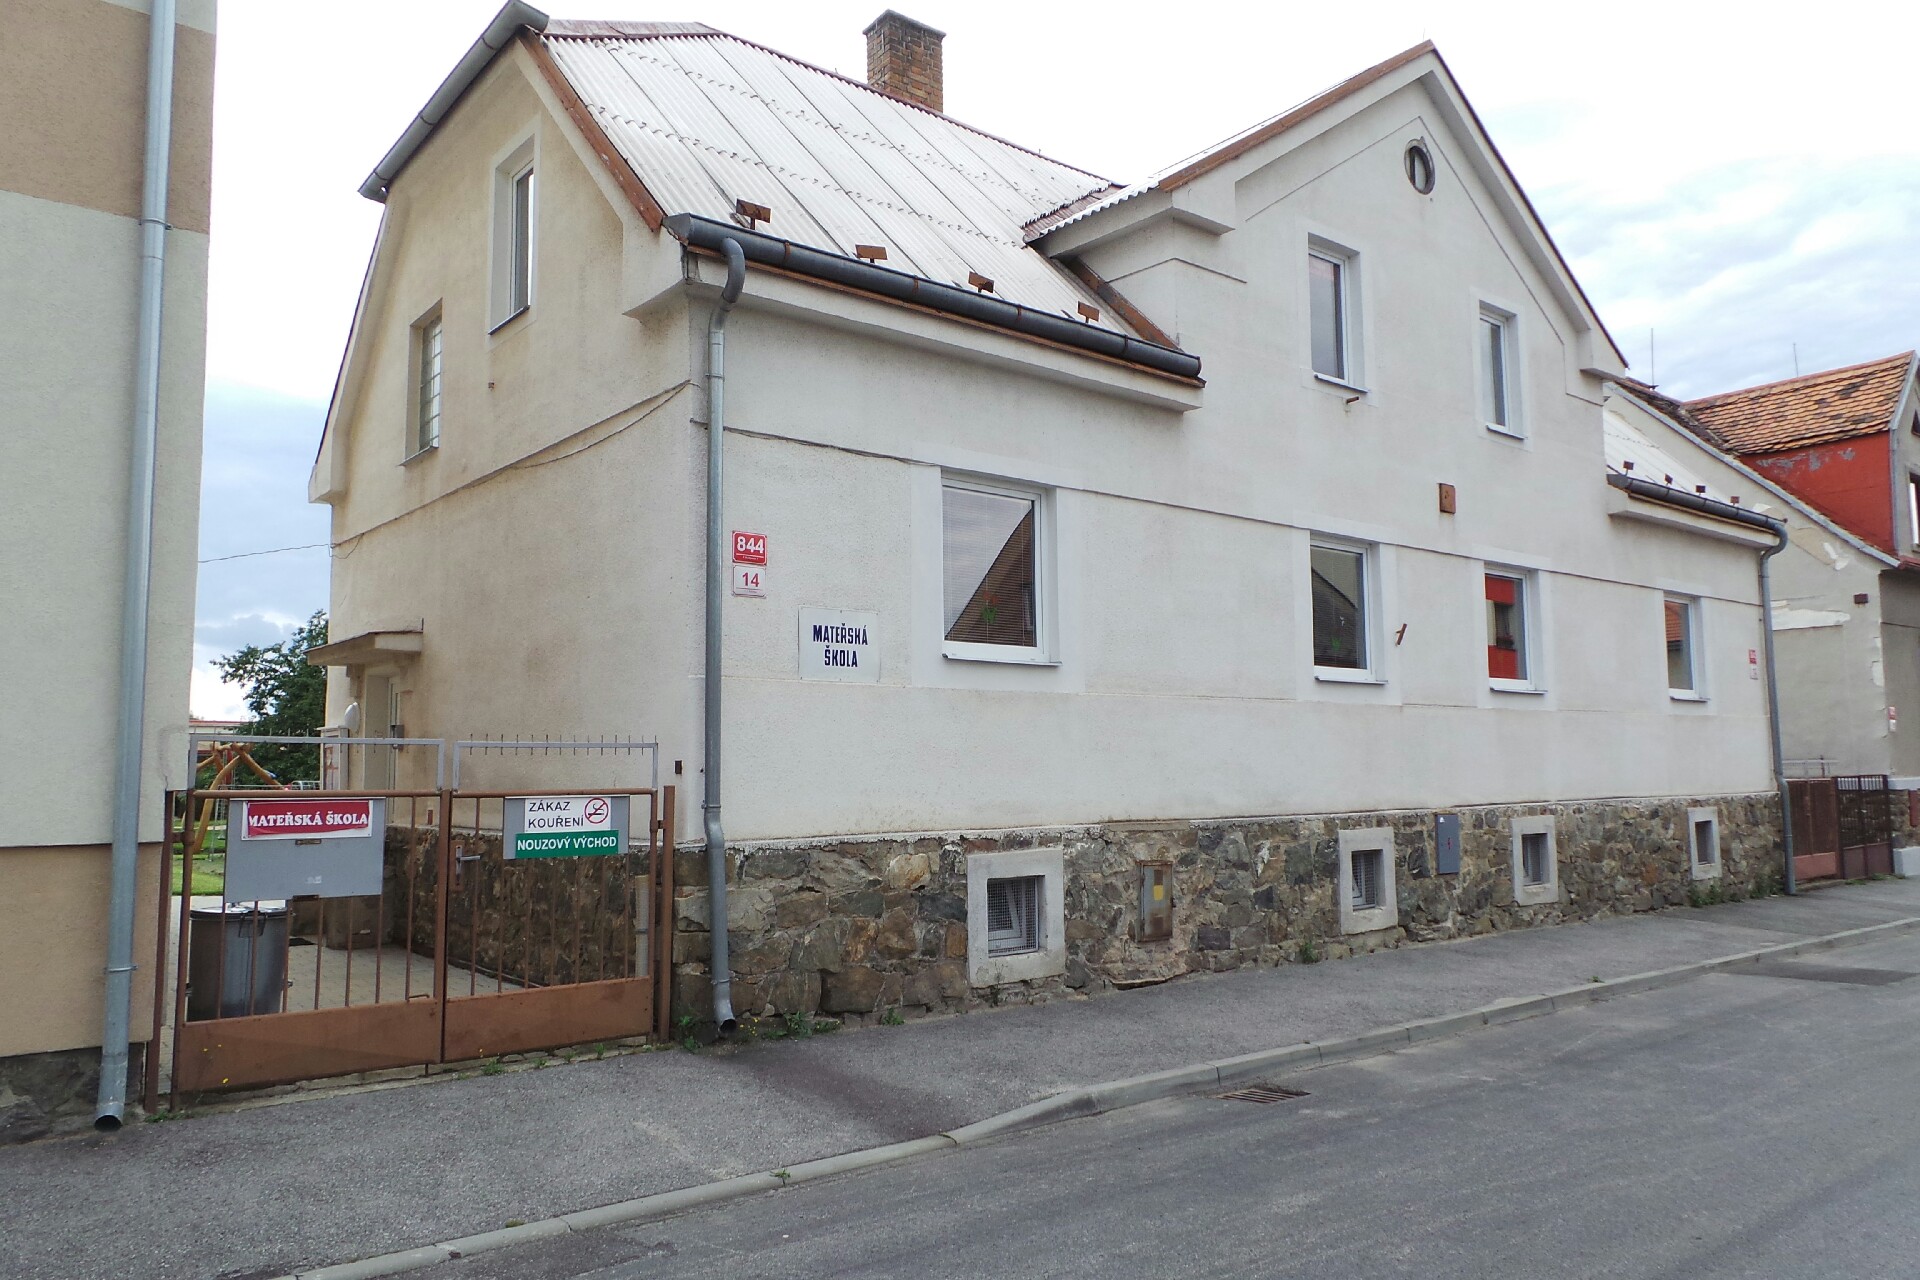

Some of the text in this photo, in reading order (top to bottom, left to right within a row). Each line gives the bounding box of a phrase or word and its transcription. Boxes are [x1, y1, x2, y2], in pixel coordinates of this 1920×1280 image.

[737, 536, 765, 554] 844
[742, 572, 760, 587] 14
[812, 623, 869, 645] MATEŘSKÁ
[824, 645, 858, 668] ŠKOLA
[528, 799, 571, 812] ZÁKAZ
[249, 810, 368, 827] MATEŘSKÁ ŠKOLA
[528, 815, 584, 828] KOUŘENÍ
[517, 835, 617, 851] NOUZOVÝ VÝCHOD
